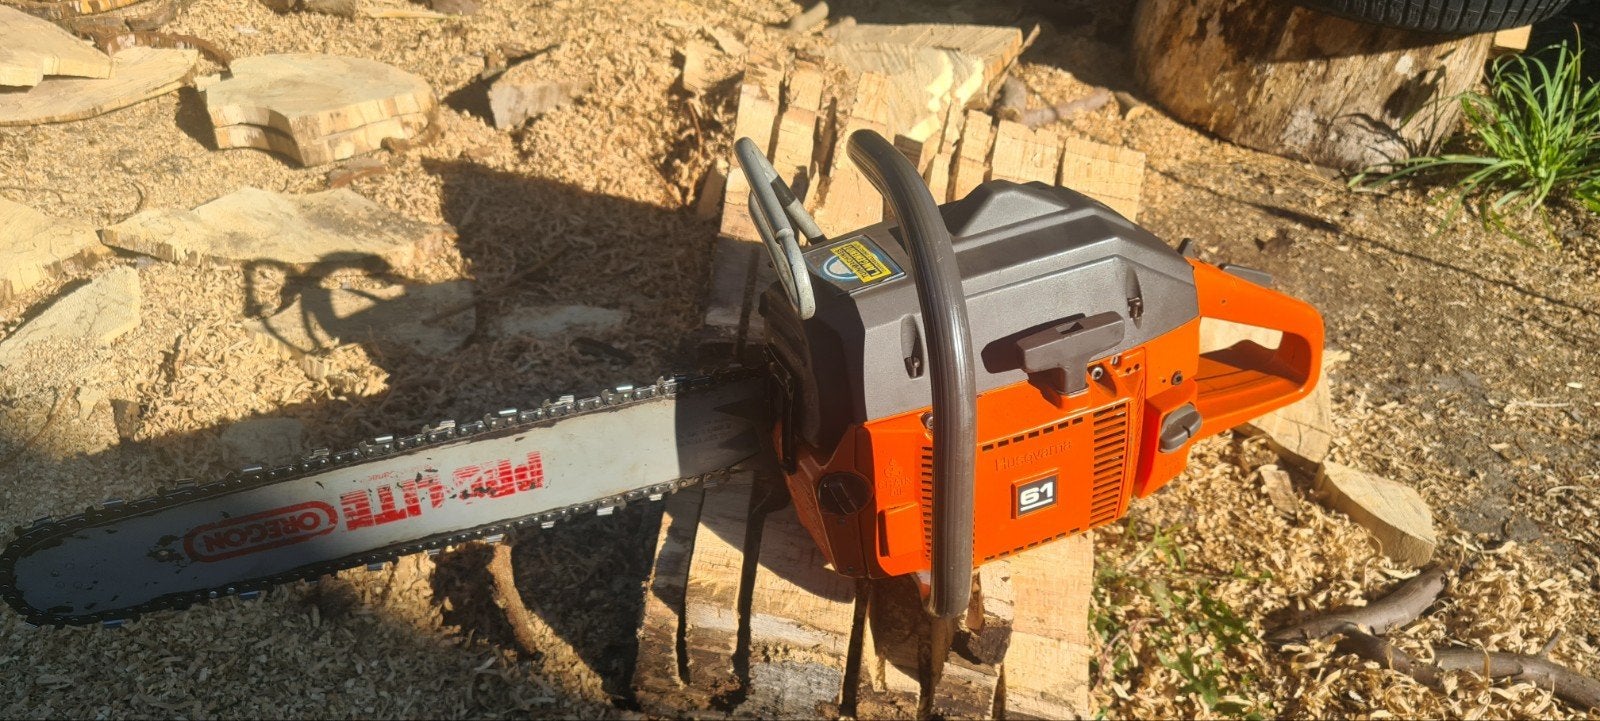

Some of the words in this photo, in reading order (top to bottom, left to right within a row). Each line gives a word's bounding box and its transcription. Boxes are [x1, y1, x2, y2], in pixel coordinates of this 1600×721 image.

[994, 440, 1072, 471] Husqvarna
[340, 474, 450, 532] LITE
[1020, 481, 1054, 506] 61
[203, 511, 321, 553] OREGON
